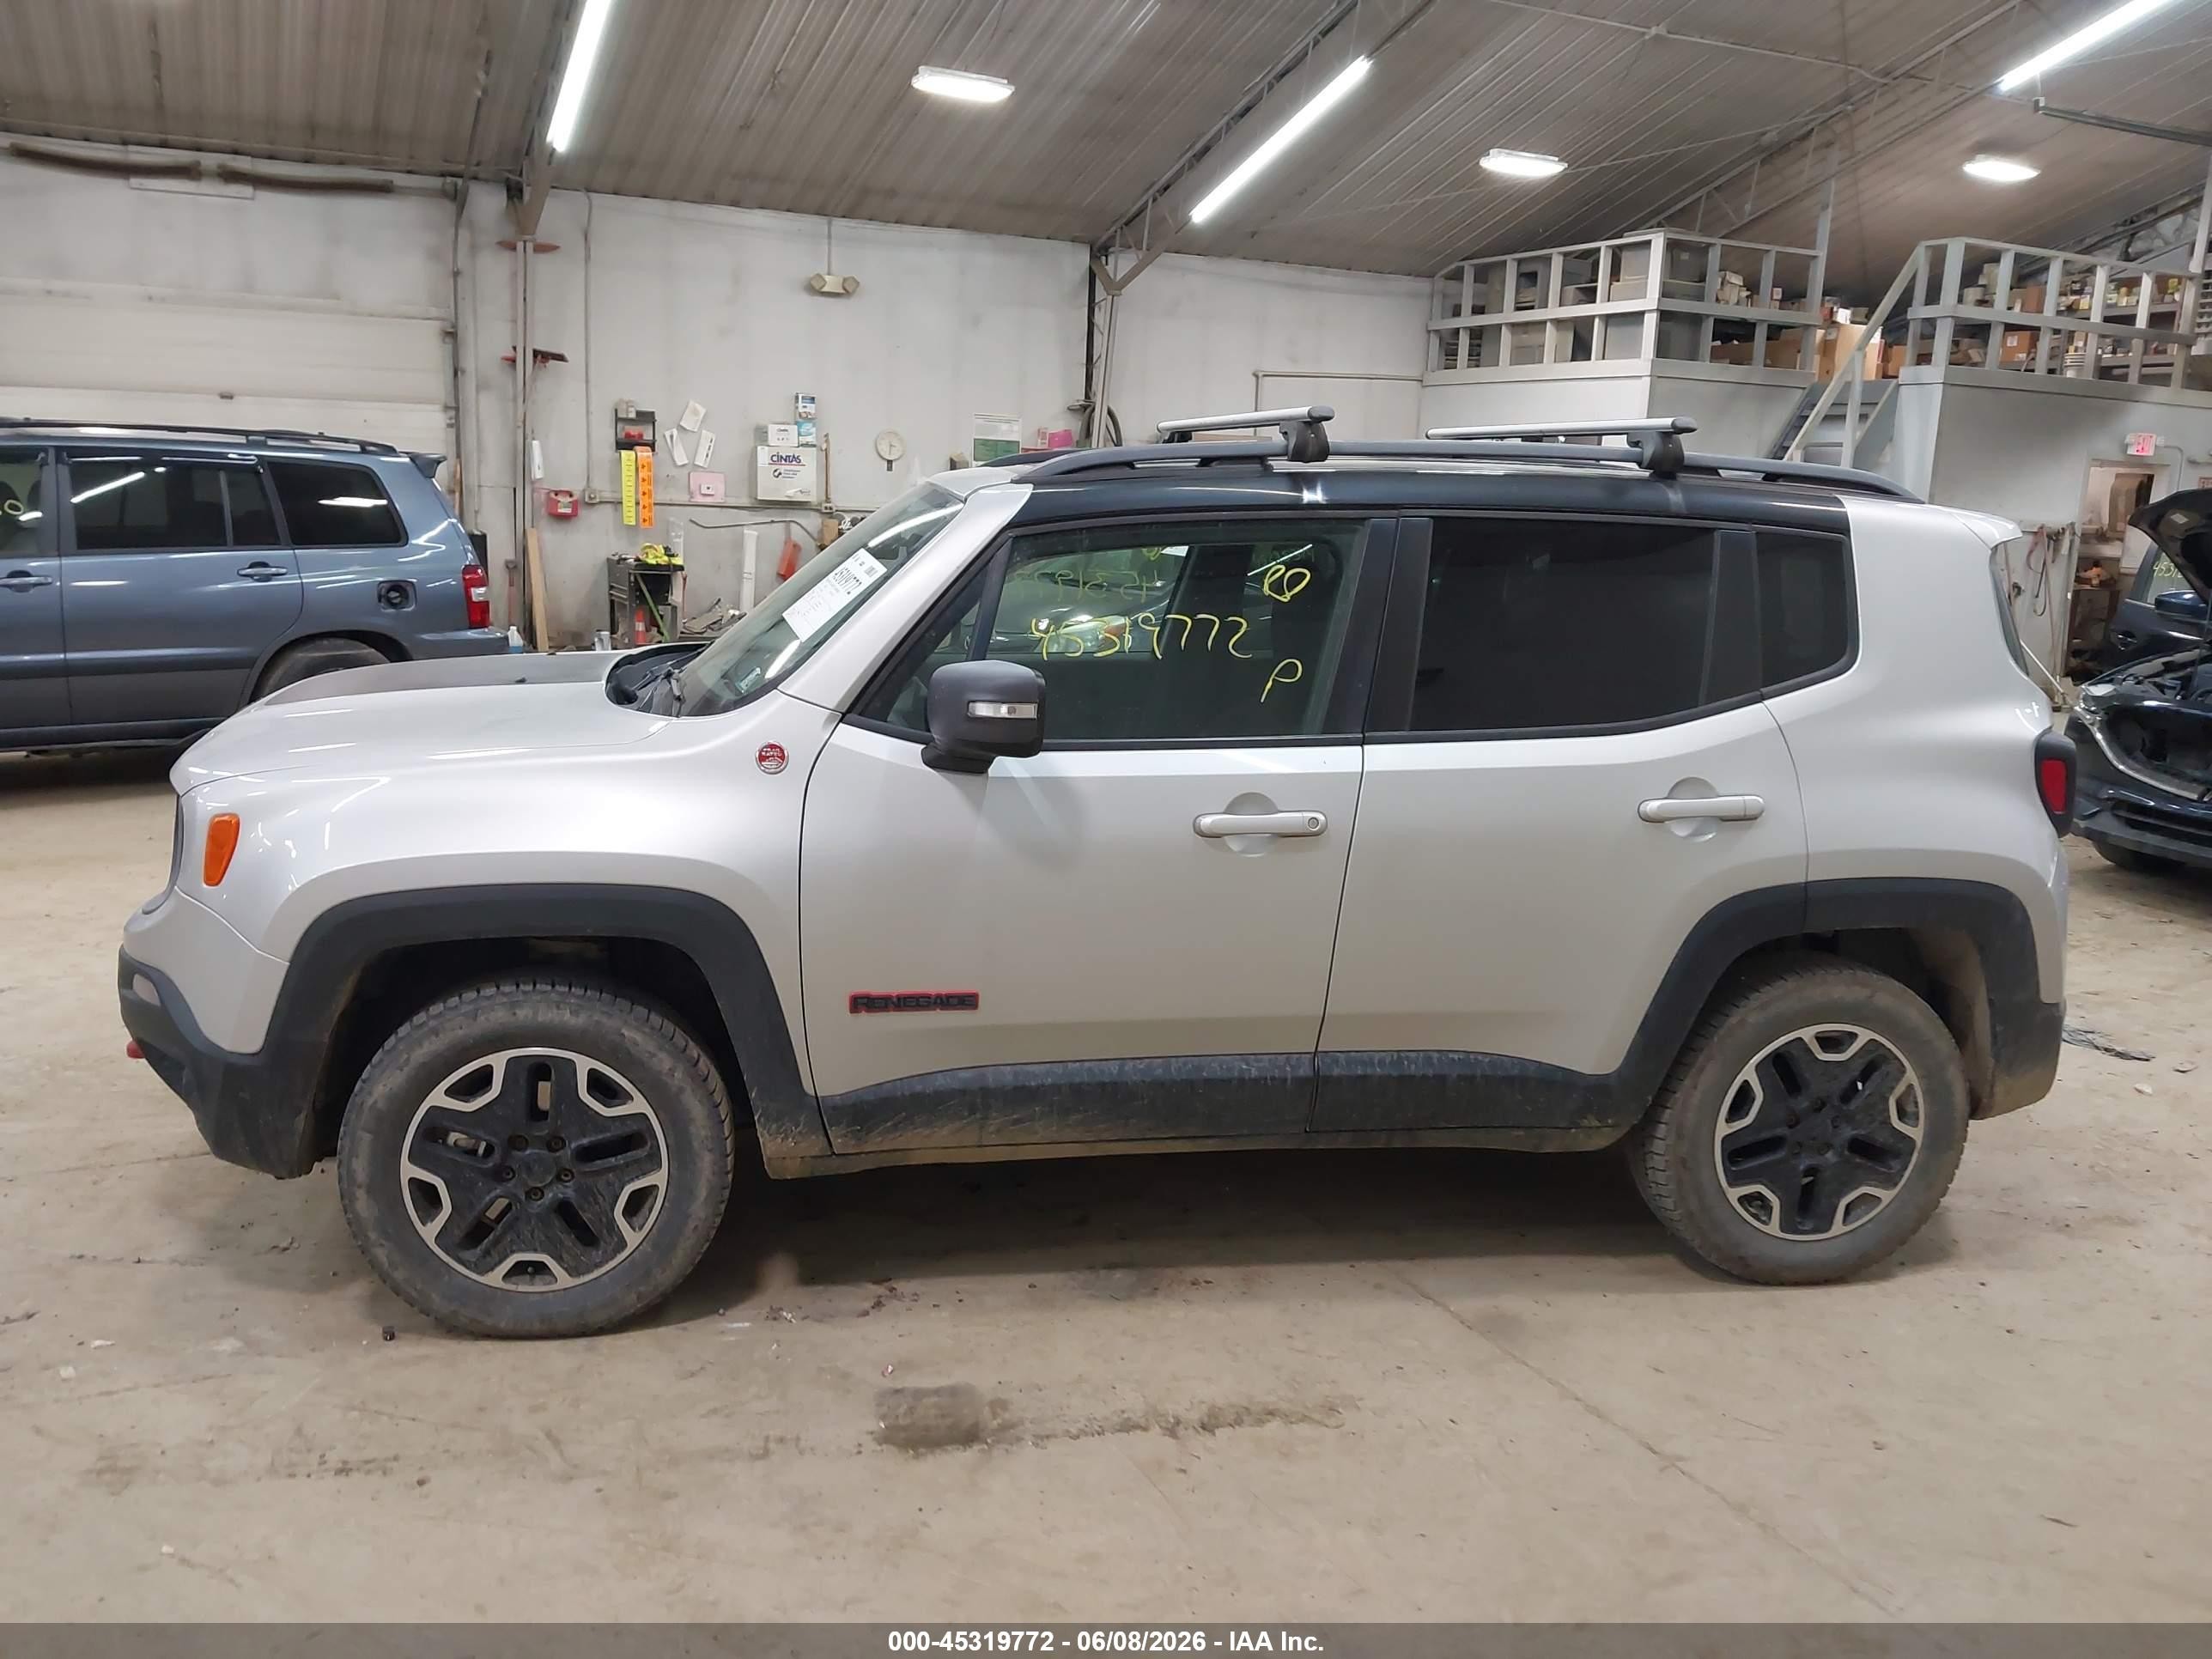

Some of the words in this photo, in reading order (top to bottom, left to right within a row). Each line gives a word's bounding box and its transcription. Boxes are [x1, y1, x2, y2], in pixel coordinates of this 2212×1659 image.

[770, 451, 801, 464] CINTAS
[1030, 612, 1253, 660] 45319772
[1260, 659, 1303, 703] P
[850, 993, 978, 1012] RENEGADE
